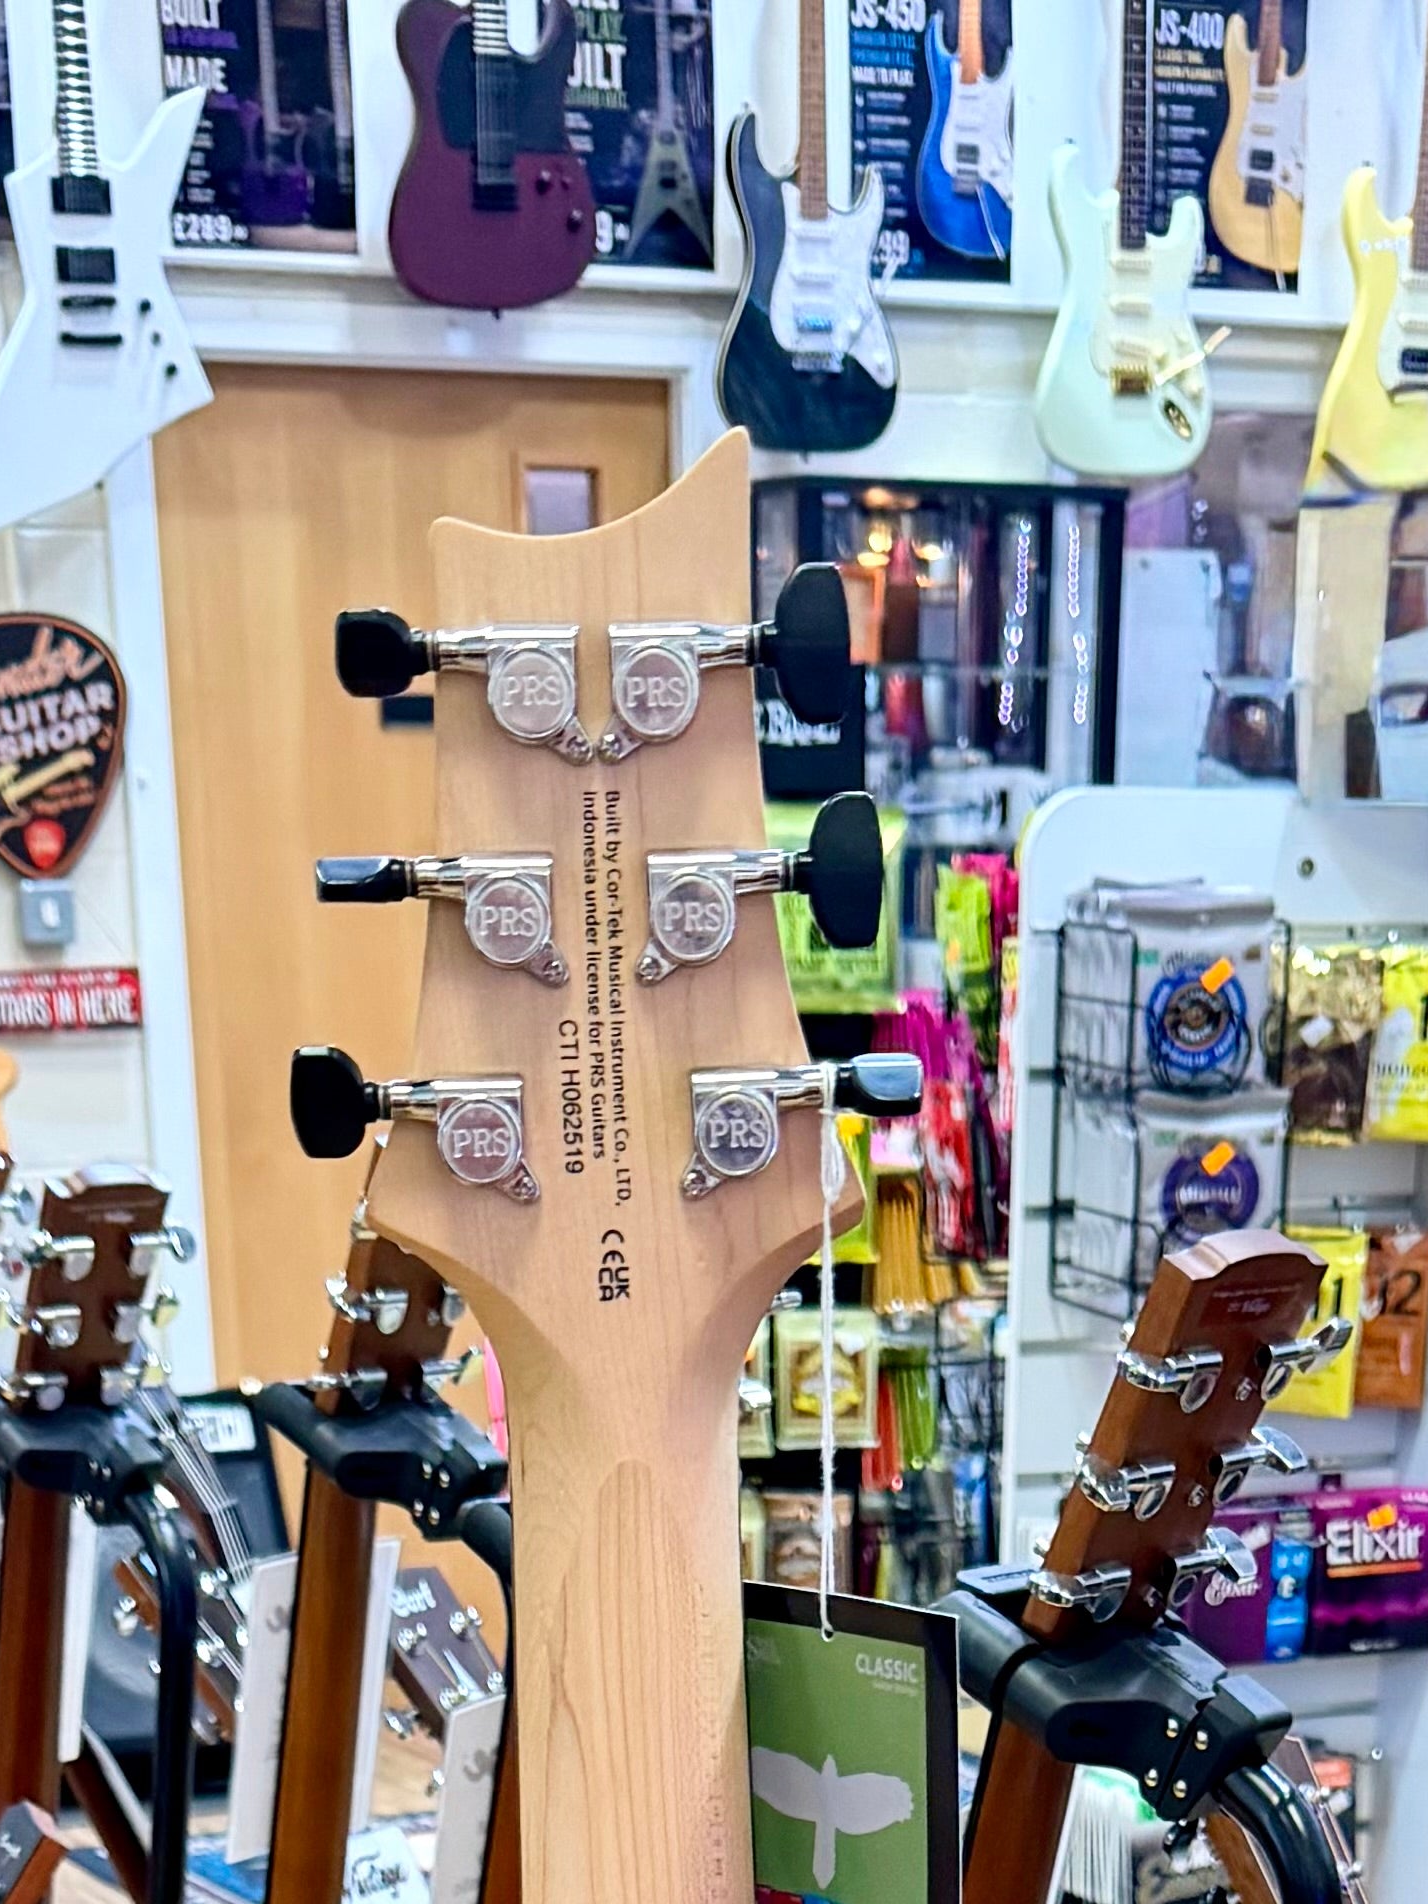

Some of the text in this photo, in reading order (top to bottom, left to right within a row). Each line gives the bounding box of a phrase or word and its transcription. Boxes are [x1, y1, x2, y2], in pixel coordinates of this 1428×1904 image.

[1156, 9, 1224, 49] JS-400
[500, 675, 563, 707] PRS
[624, 675, 687, 707] PRS
[604, 790, 621, 835] Built
[603, 841, 622, 863] by
[479, 904, 538, 937] PRS
[606, 868, 624, 940] Cor-Tek
[663, 901, 722, 933] PRS
[583, 790, 607, 1160] Indonesia under license for PRS Guitars
[608, 945, 626, 1015] Musical
[610, 1020, 628, 1122] Instrument
[560, 1068, 585, 1175] H062519
[708, 1118, 769, 1149] PRS
[452, 1127, 510, 1159] PRS
[1326, 1516, 1424, 1567] Elixir
[854, 1653, 918, 1684] CLASSIC
